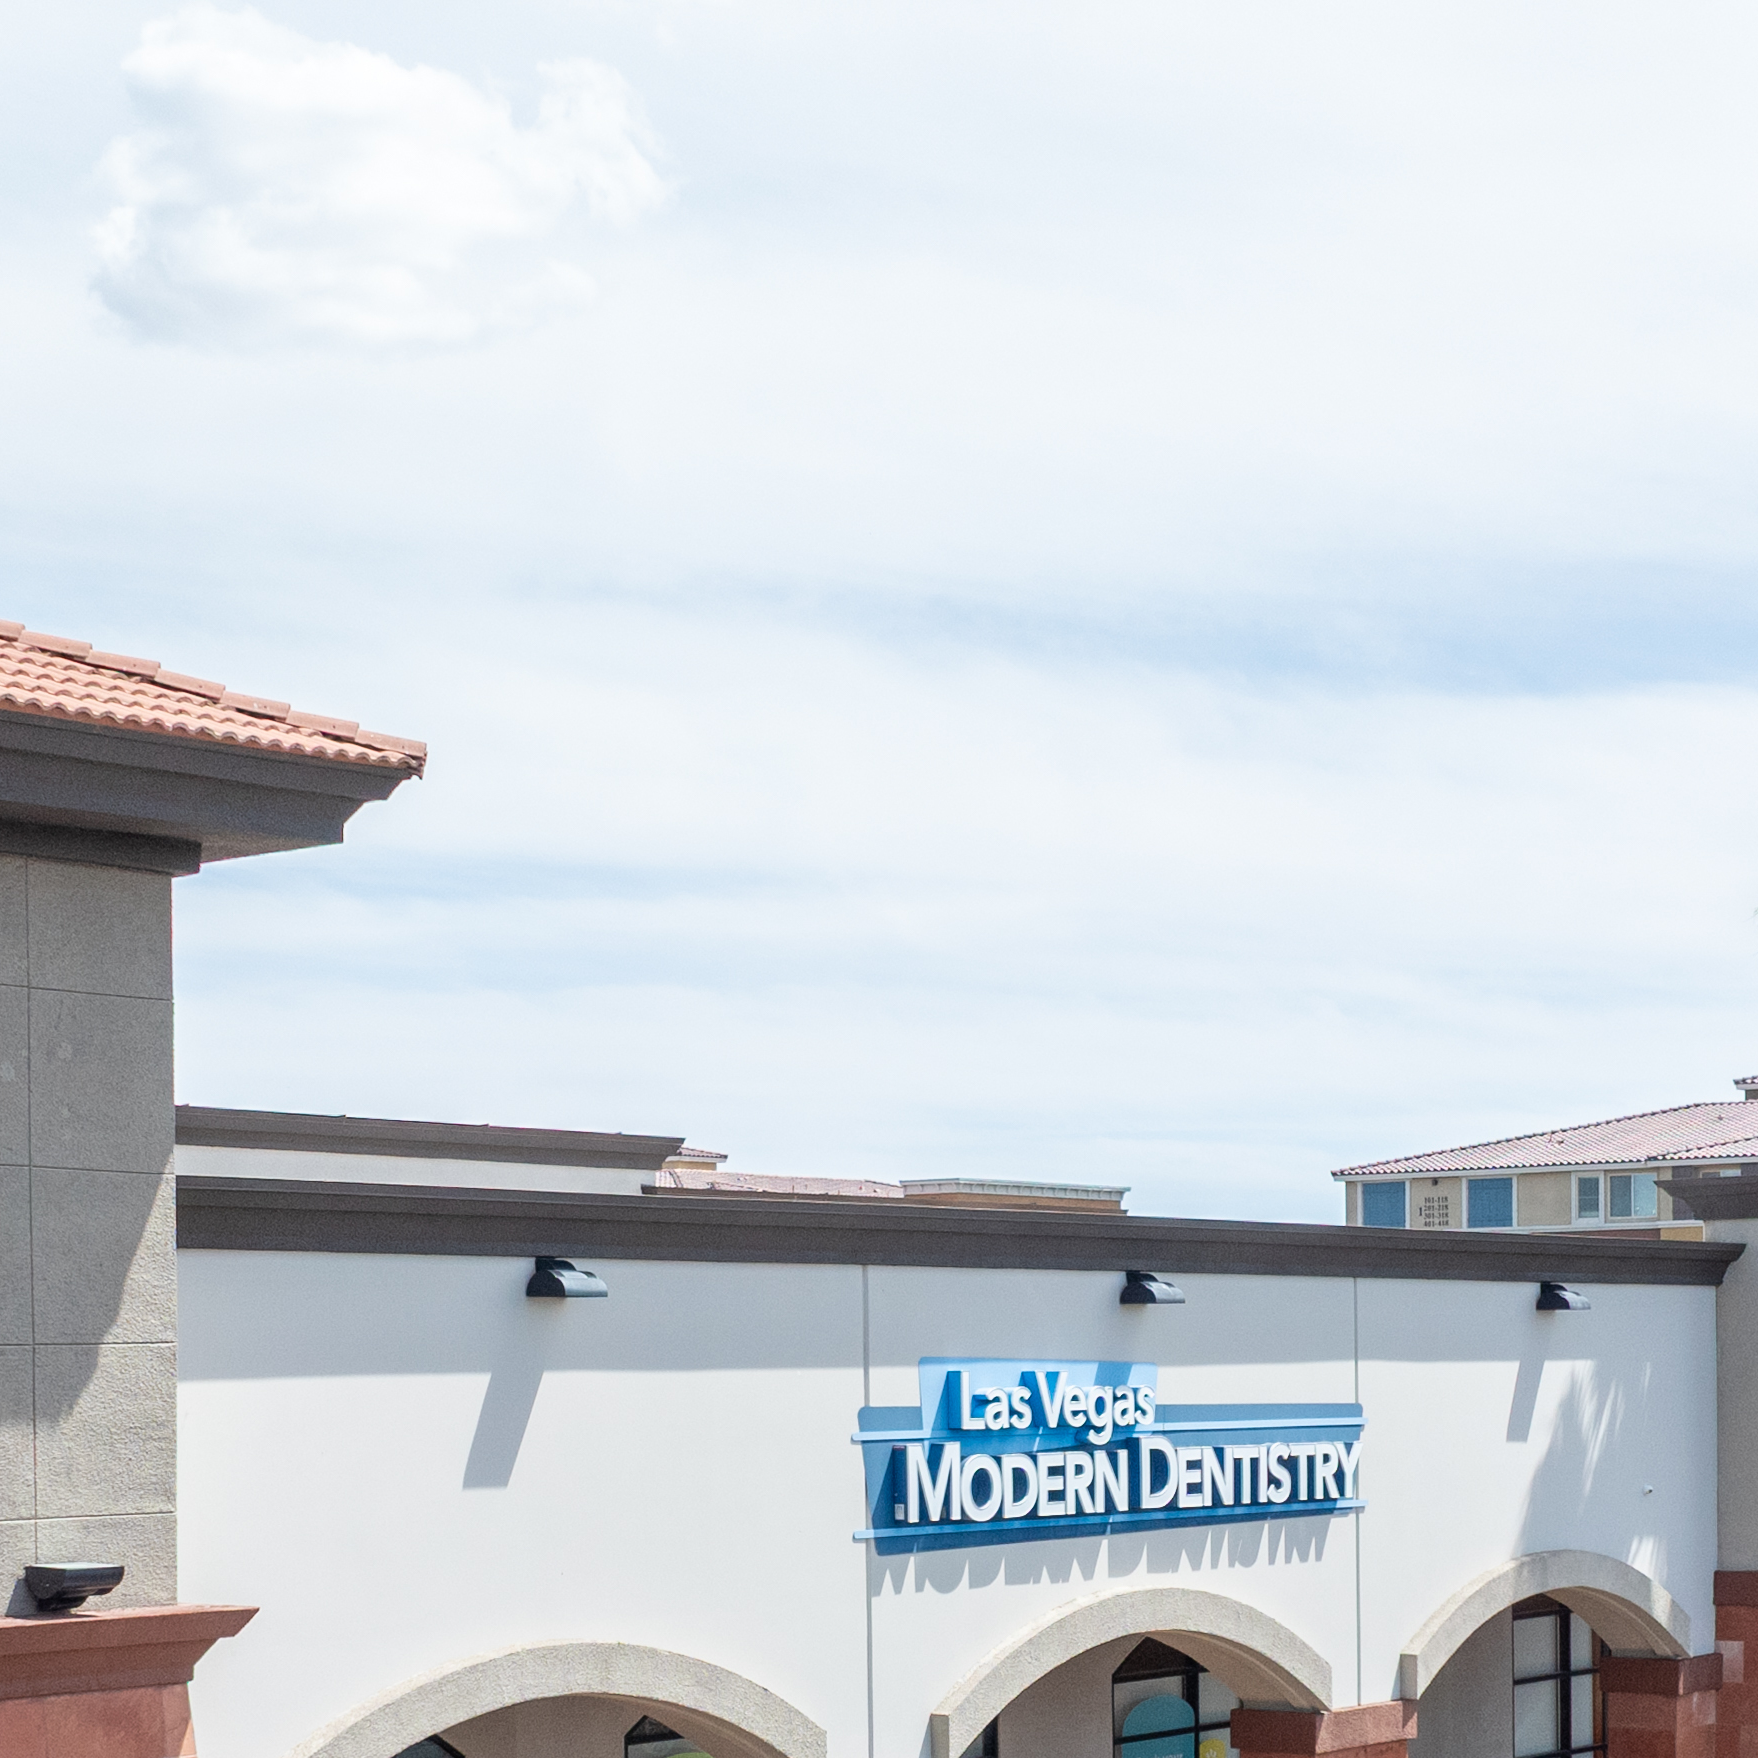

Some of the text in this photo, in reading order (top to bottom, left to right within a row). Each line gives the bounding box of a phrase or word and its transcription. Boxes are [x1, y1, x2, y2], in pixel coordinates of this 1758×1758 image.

[961, 1370, 1156, 1445] Las Vegas
[905, 1435, 1364, 1523] MODERN DENTISTRY
